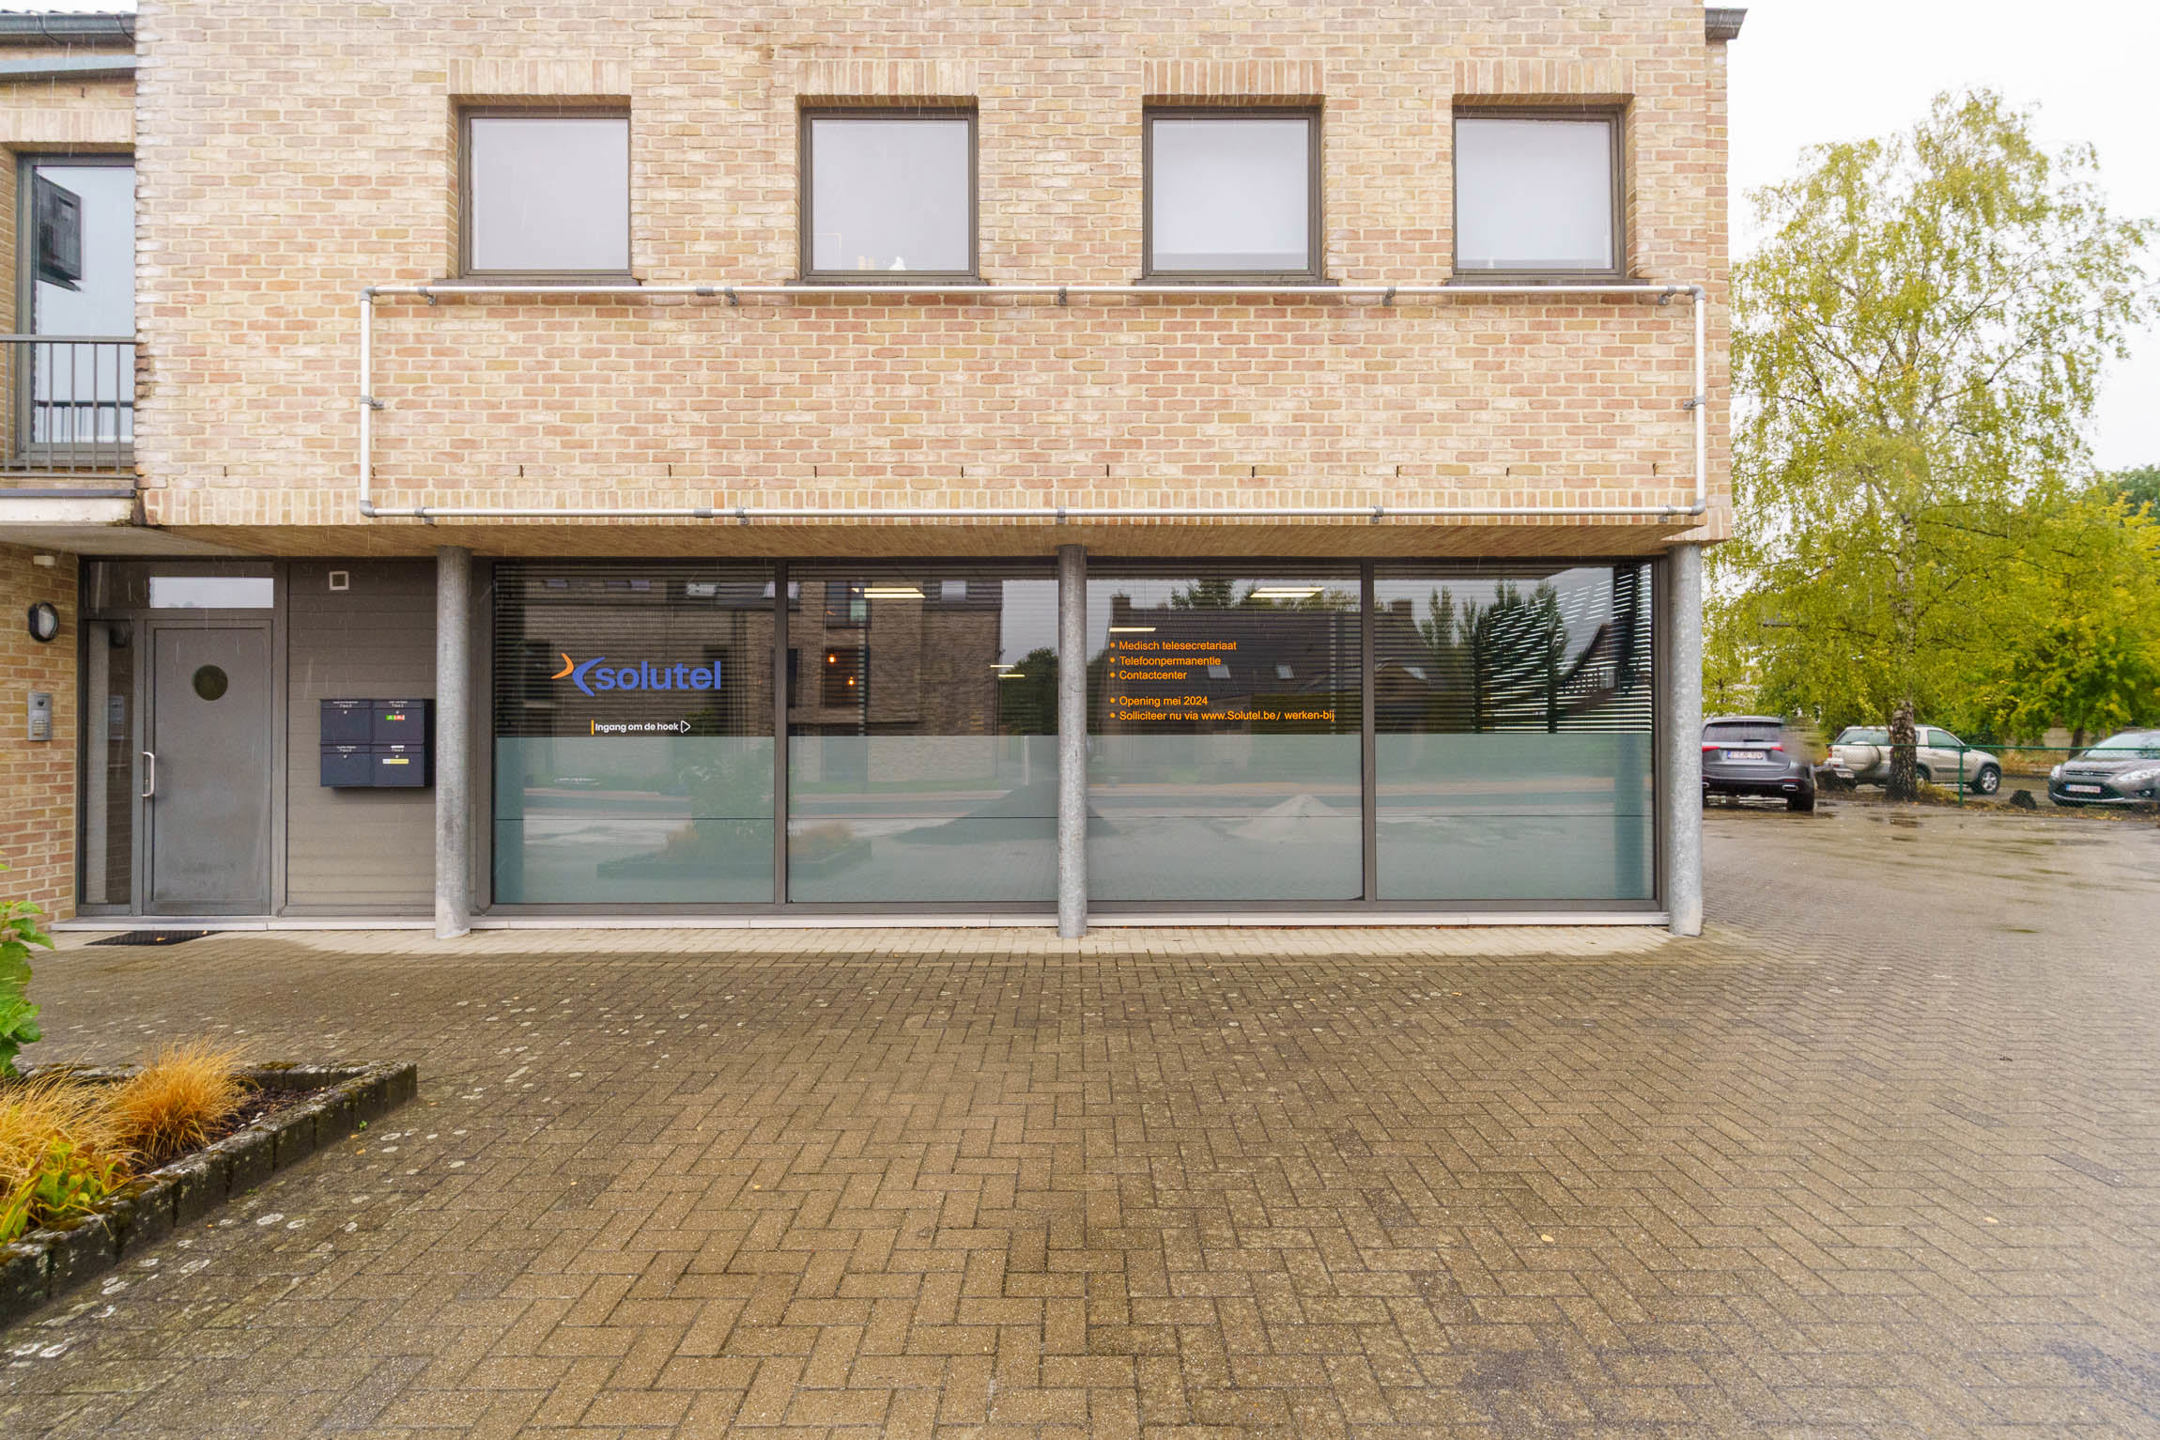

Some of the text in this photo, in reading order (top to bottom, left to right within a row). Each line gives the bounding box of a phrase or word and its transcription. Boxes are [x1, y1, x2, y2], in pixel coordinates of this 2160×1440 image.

[1119, 640, 1237, 651] Medisch telesecretariaat
[1119, 655, 1222, 667] Telefoonpermanentie
[595, 661, 721, 690] solutel
[1119, 669, 1188, 681] Contactcenter
[1119, 695, 1208, 708] Opening mei 2024
[1119, 710, 1167, 721] Solliciteer
[1169, 711, 1181, 721] nu
[1184, 710, 1199, 721] via
[1284, 709, 1335, 723] werken-bij
[595, 722, 679, 734] Ingang om de hoek
